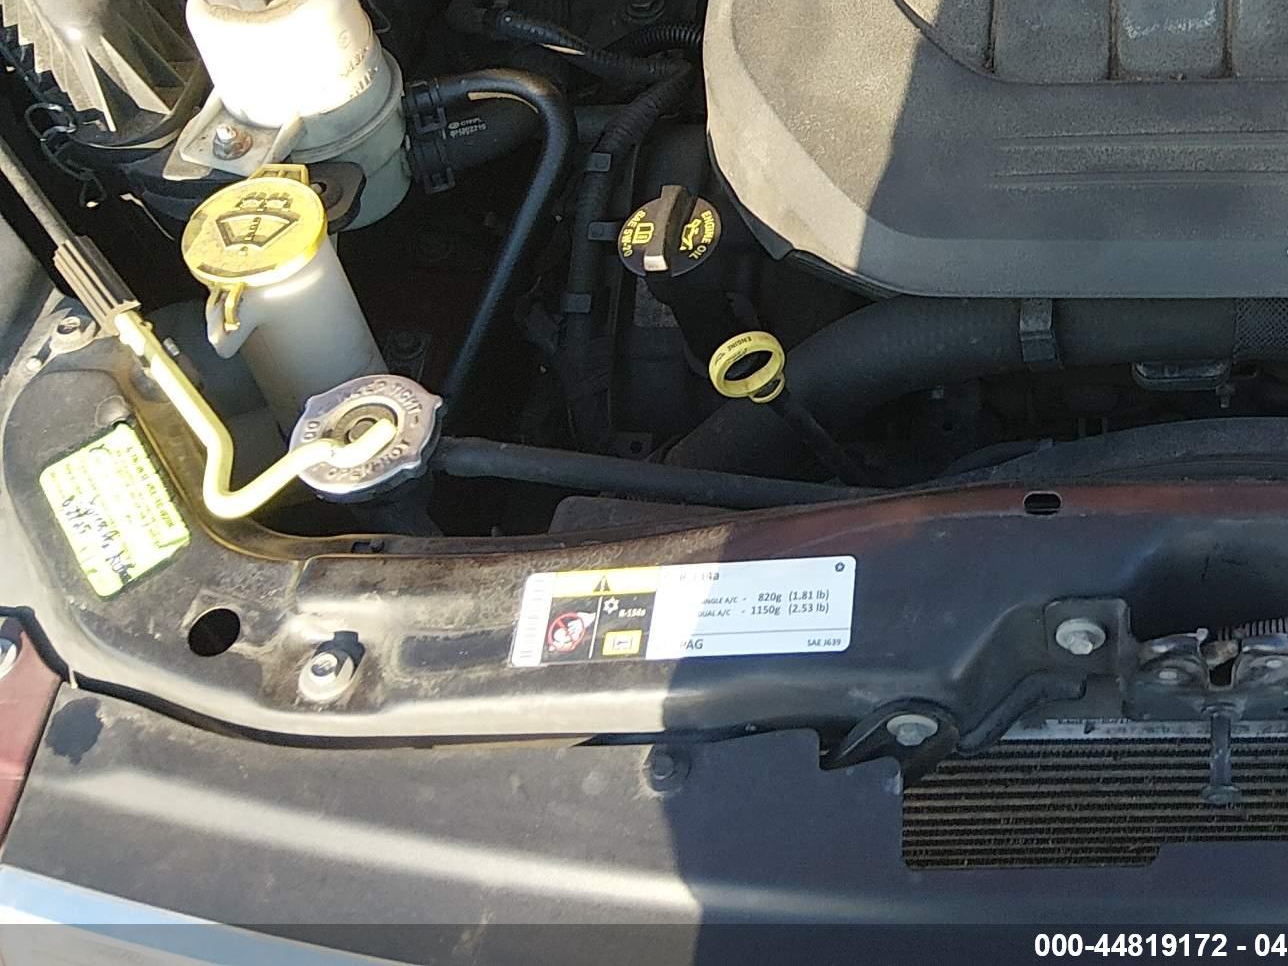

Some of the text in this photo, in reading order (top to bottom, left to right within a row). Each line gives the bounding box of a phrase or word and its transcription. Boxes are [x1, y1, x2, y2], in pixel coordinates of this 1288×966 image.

[627, 210, 646, 228] SAE
[688, 210, 715, 259] ENGINE OIL
[727, 336, 753, 351] ENGINE
[701, 597, 723, 605] INGLE
[724, 596, 738, 604] A/C
[757, 592, 782, 603] 820g
[788, 590, 813, 601] (1.81
[816, 589, 830, 601] lb)
[717, 609, 731, 617] A/C
[751, 605, 781, 616] 1150g
[788, 604, 813, 615] (2.53
[816, 602, 830, 614] lb)
[807, 637, 842, 647] SAE J639
